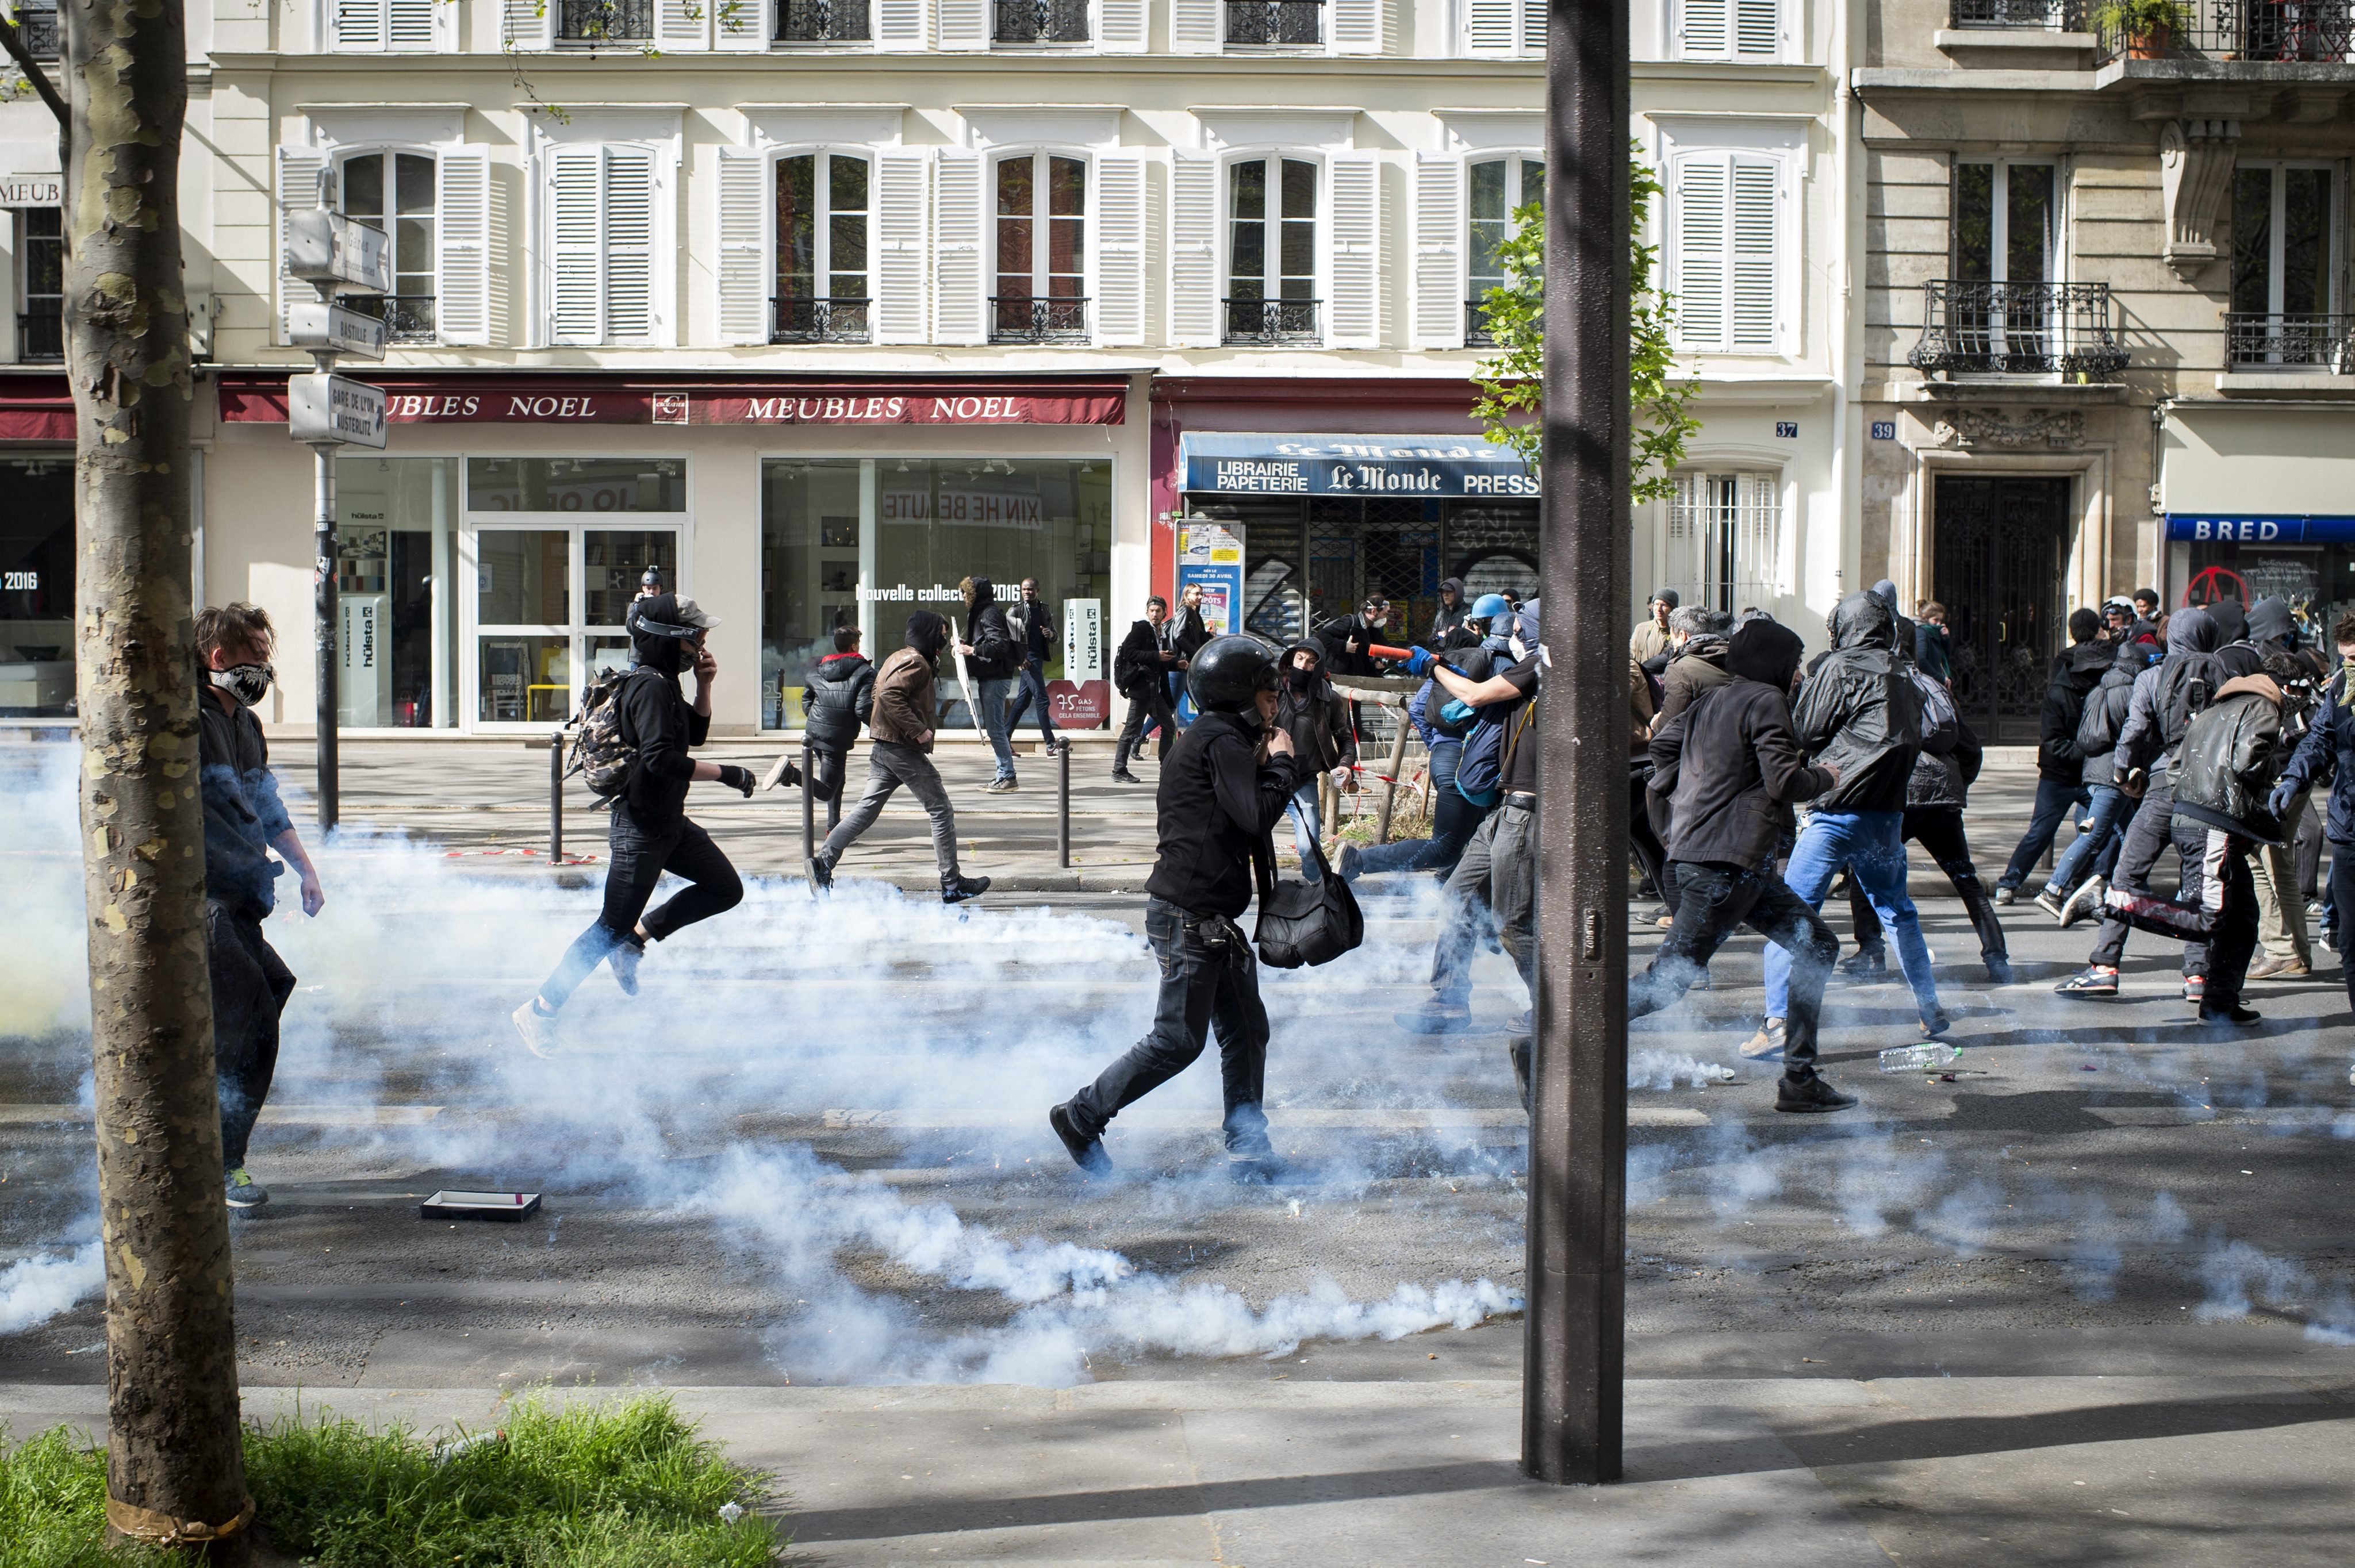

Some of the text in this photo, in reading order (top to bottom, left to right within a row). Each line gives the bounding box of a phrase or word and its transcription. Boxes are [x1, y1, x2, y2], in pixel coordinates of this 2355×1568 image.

[0, 184, 59, 202] MEUB
[348, 232, 369, 253] Gares
[340, 321, 367, 343] BASTILLE
[332, 388, 375, 414] GARE DE LYON
[386, 395, 596, 417] UBLES NOEL
[745, 396, 1021, 419] MEUBLES NOEL
[337, 413, 371, 437] AUSTERLITZ
[1777, 422, 1796, 437] 37
[1874, 424, 1893, 439] 39
[1273, 443, 1497, 459] Le Monde
[1217, 461, 1299, 477] LIBRAIRIE
[1327, 464, 1441, 491] Le Monde
[1217, 476, 1308, 491] PAPETERIE
[1464, 475, 1540, 494] PRESS
[2195, 520, 2279, 541] BRED
[5, 572, 37, 590] 2016
[918, 583, 966, 601] collect
[993, 584, 1021, 601] 2016
[1200, 596, 1222, 604] PÔTS
[363, 620, 373, 667] hülsta
[1088, 621, 1097, 669] hülsta
[1056, 694, 1079, 711] 75
